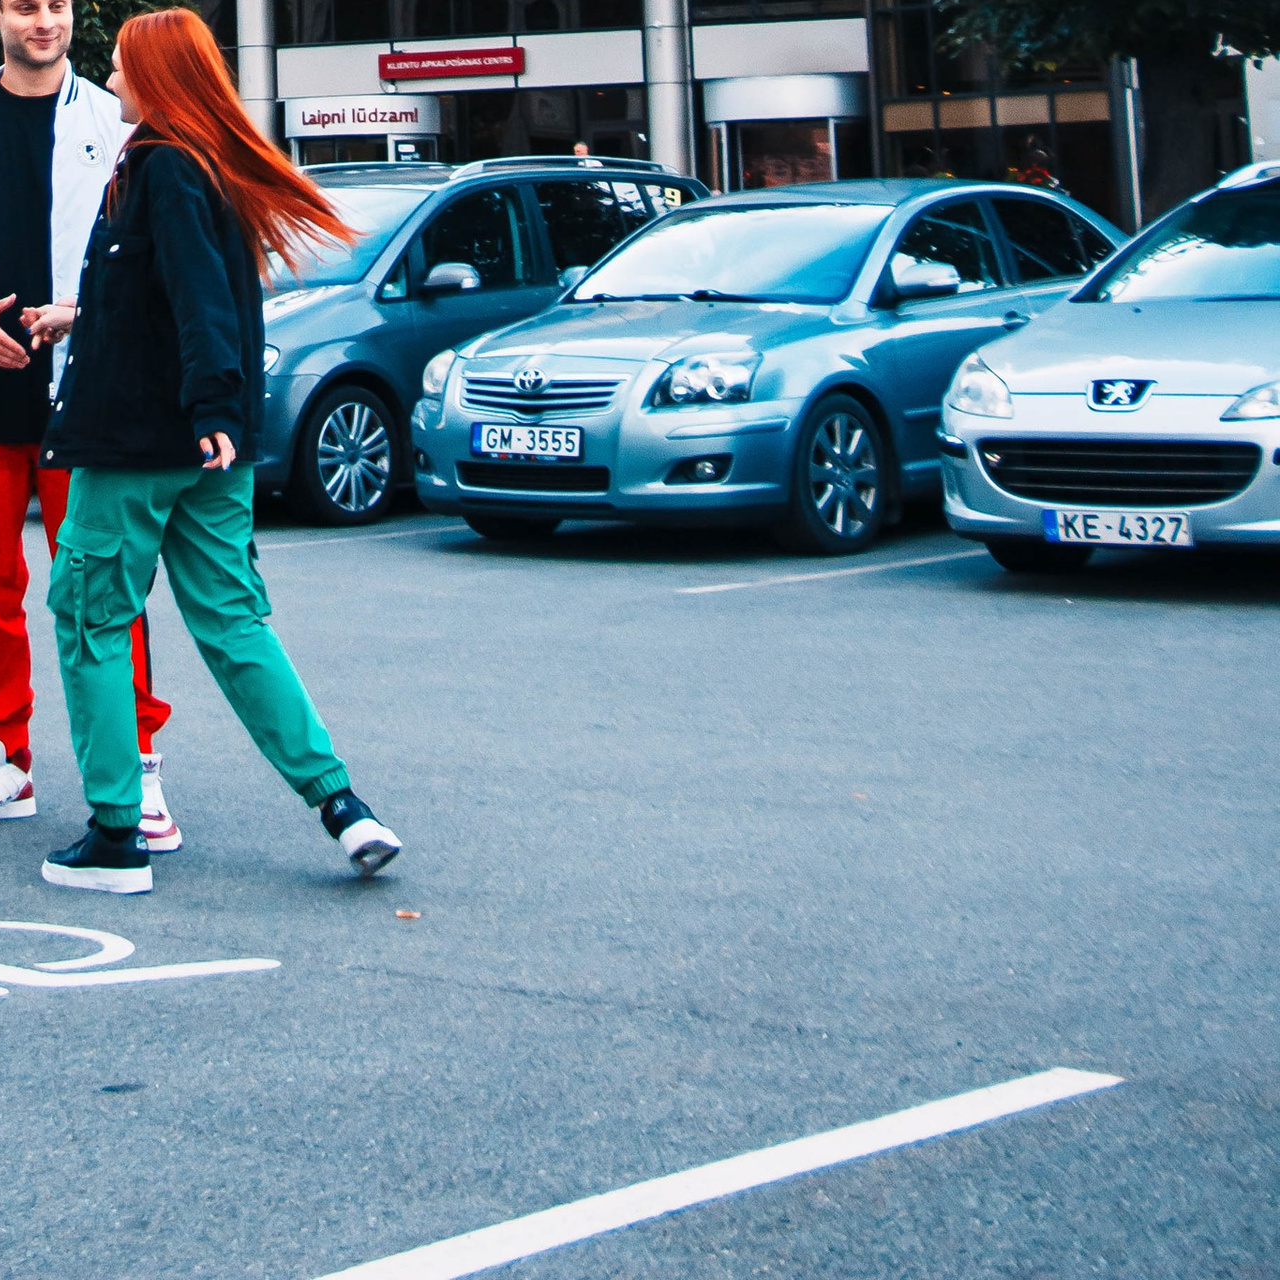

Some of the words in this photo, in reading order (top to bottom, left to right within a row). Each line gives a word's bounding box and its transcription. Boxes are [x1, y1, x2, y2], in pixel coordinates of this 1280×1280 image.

[386, 60, 420, 70] KLIENTU
[483, 55, 514, 66] CENTRS
[302, 108, 346, 129] Laipni
[486, 428, 576, 453] GM-3555
[1062, 512, 1183, 543] KE-4327
